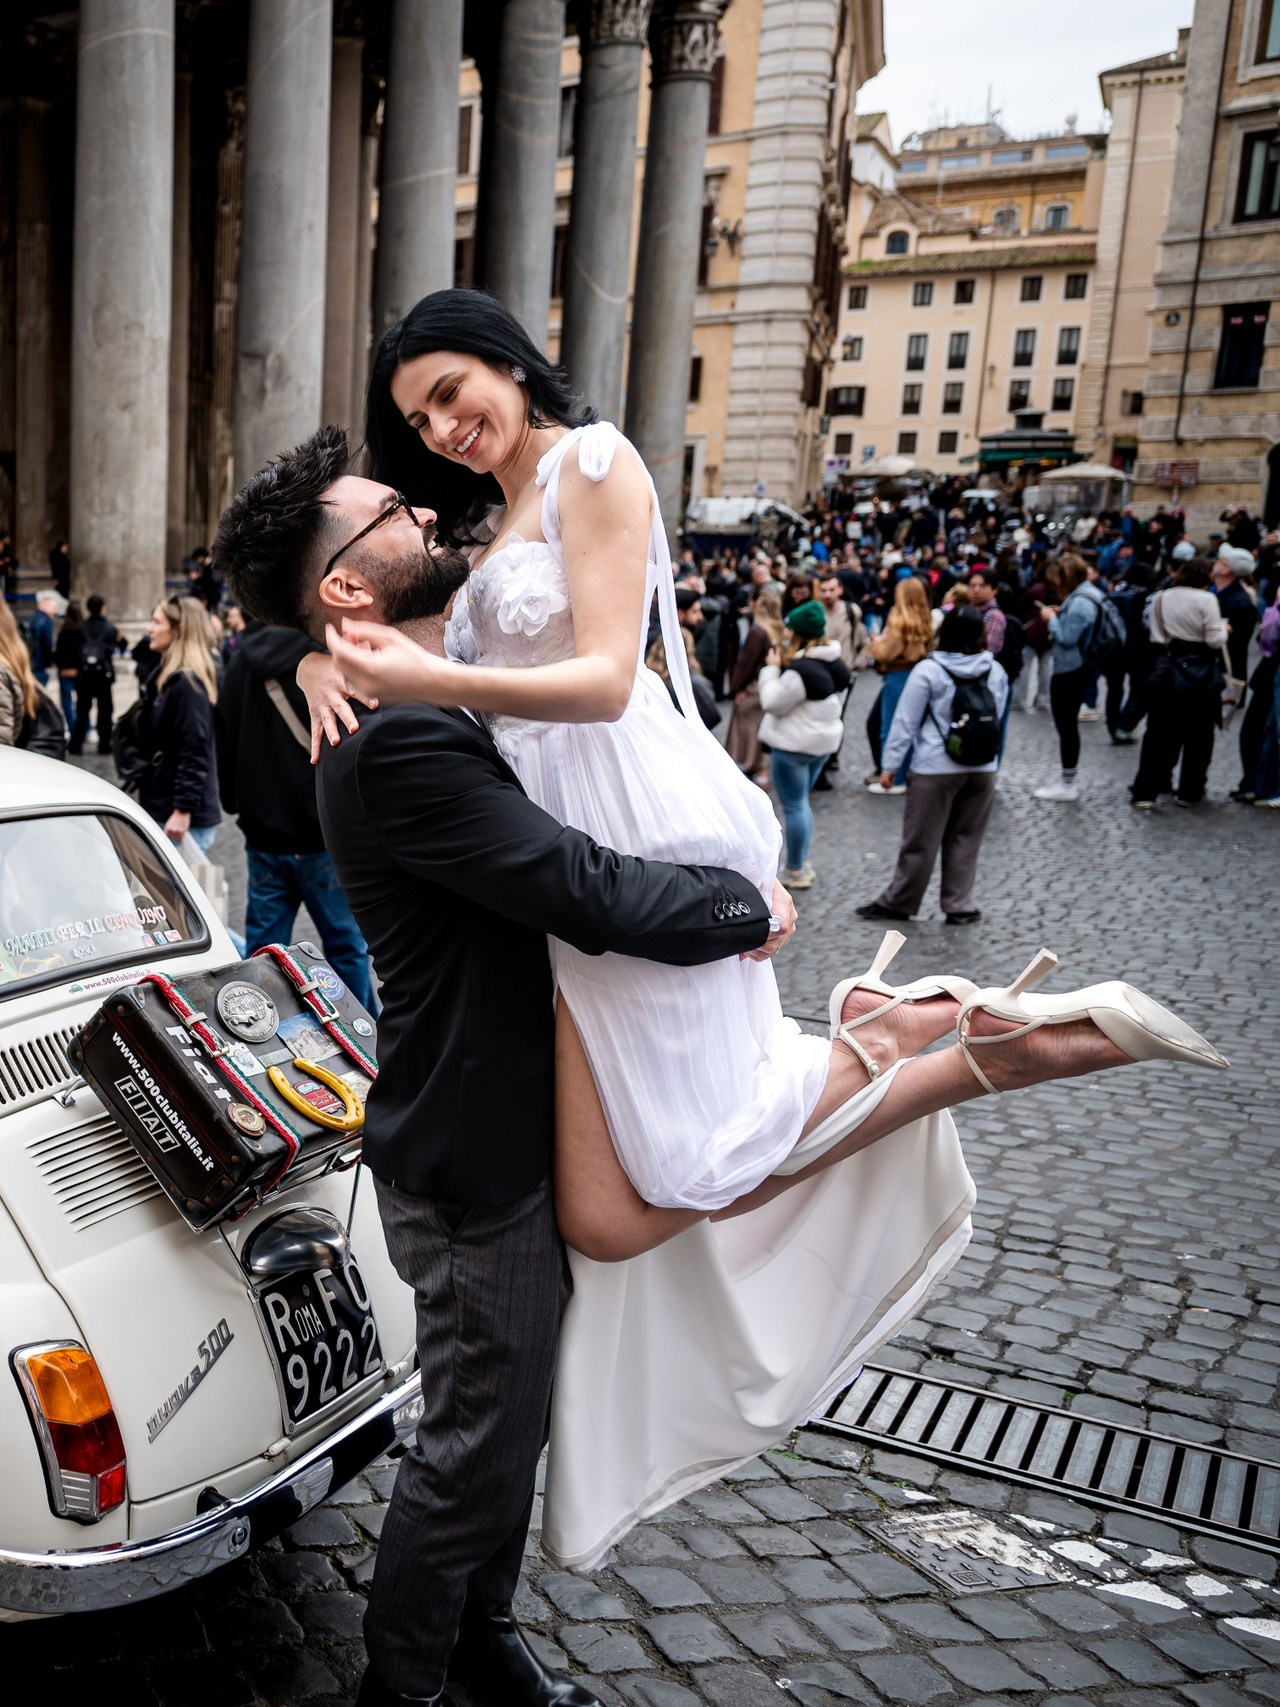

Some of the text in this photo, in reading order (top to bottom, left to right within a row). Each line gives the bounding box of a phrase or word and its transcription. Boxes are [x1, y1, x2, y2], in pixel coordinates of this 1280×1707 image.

[55, 922, 87, 944] PER
[85, 917, 105, 938] IL
[103, 904, 167, 933] CINQUINO
[164, 1025, 232, 1102] Fiat
[112, 1032, 215, 1172] www.500clubitalia.it
[120, 1081, 176, 1146] FIAT
[197, 1317, 234, 1374] 500
[287, 1316, 381, 1417] 9222
